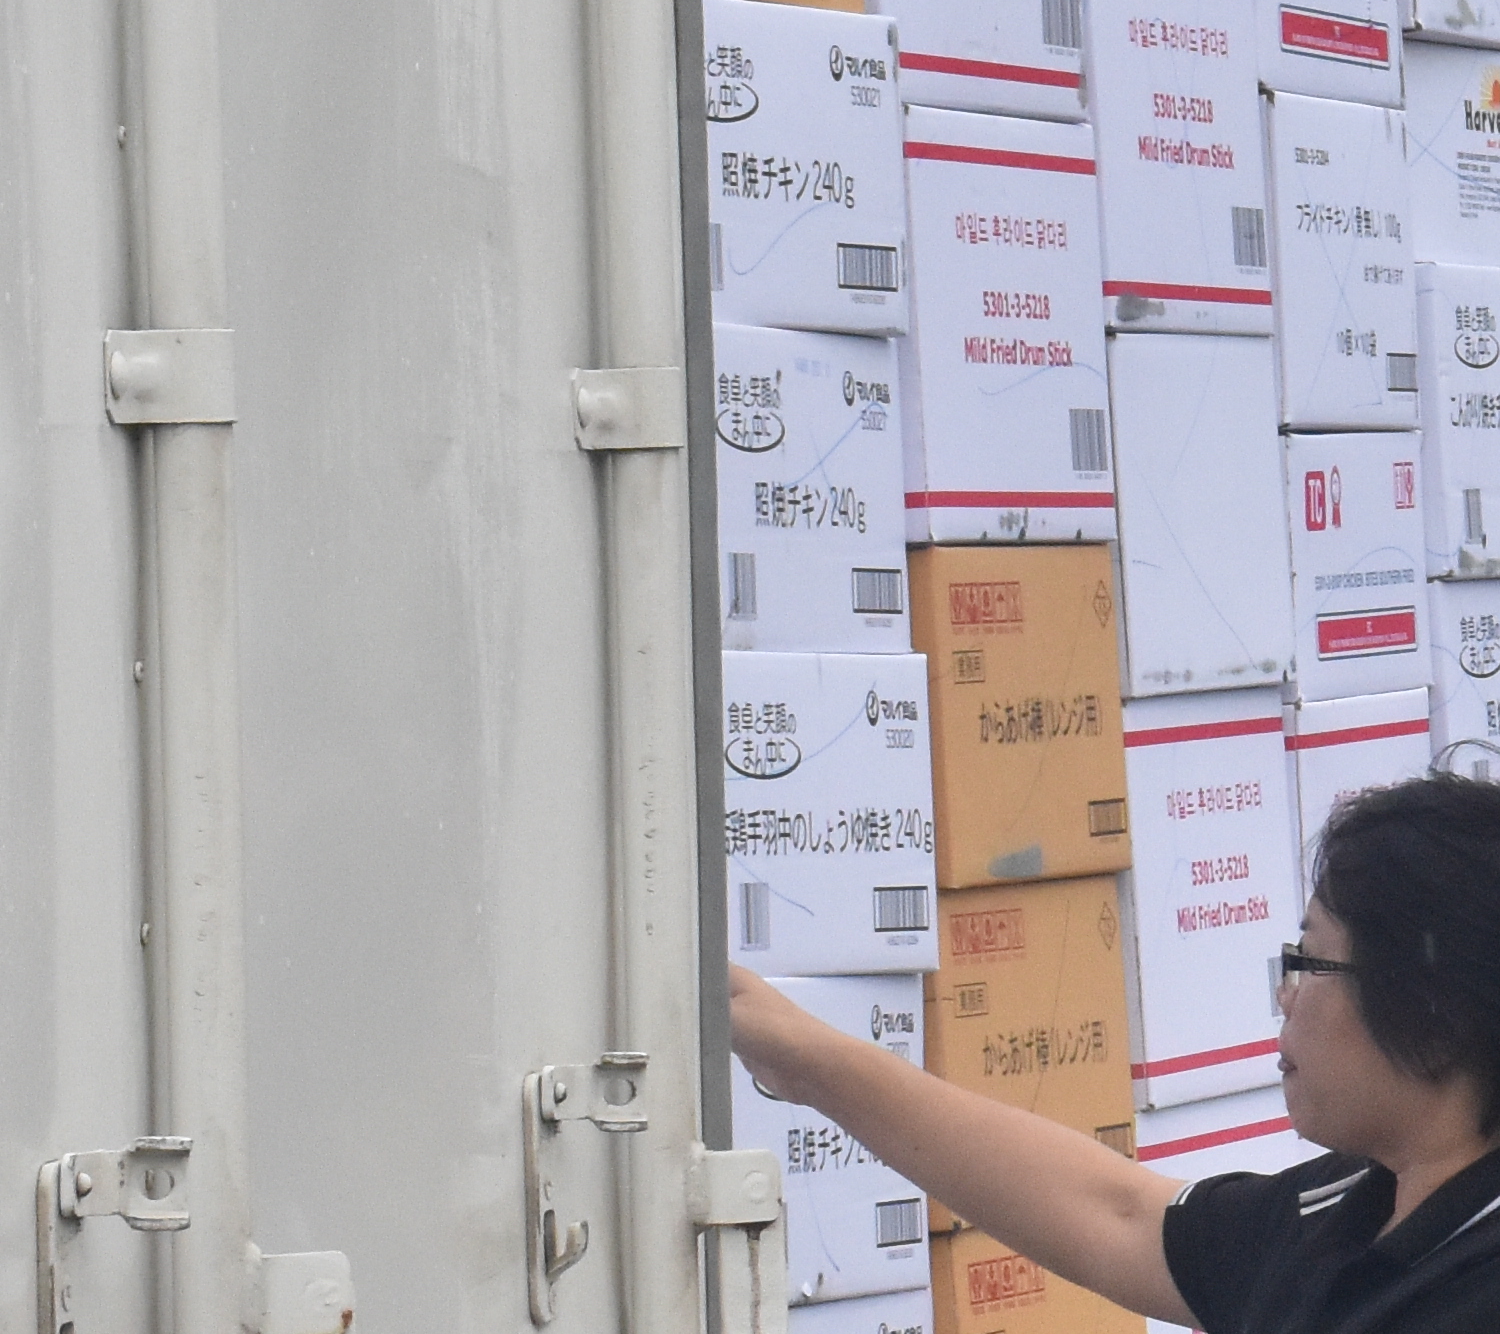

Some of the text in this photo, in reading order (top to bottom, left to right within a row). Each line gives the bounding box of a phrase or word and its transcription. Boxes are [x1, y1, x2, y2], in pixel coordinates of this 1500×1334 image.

[1137, 135, 1235, 170] Mild Fried Drum Stick
[963, 336, 1073, 368] Mild Fried Drum Stick
[1176, 896, 1271, 933] Mild Fried Drum Stick
